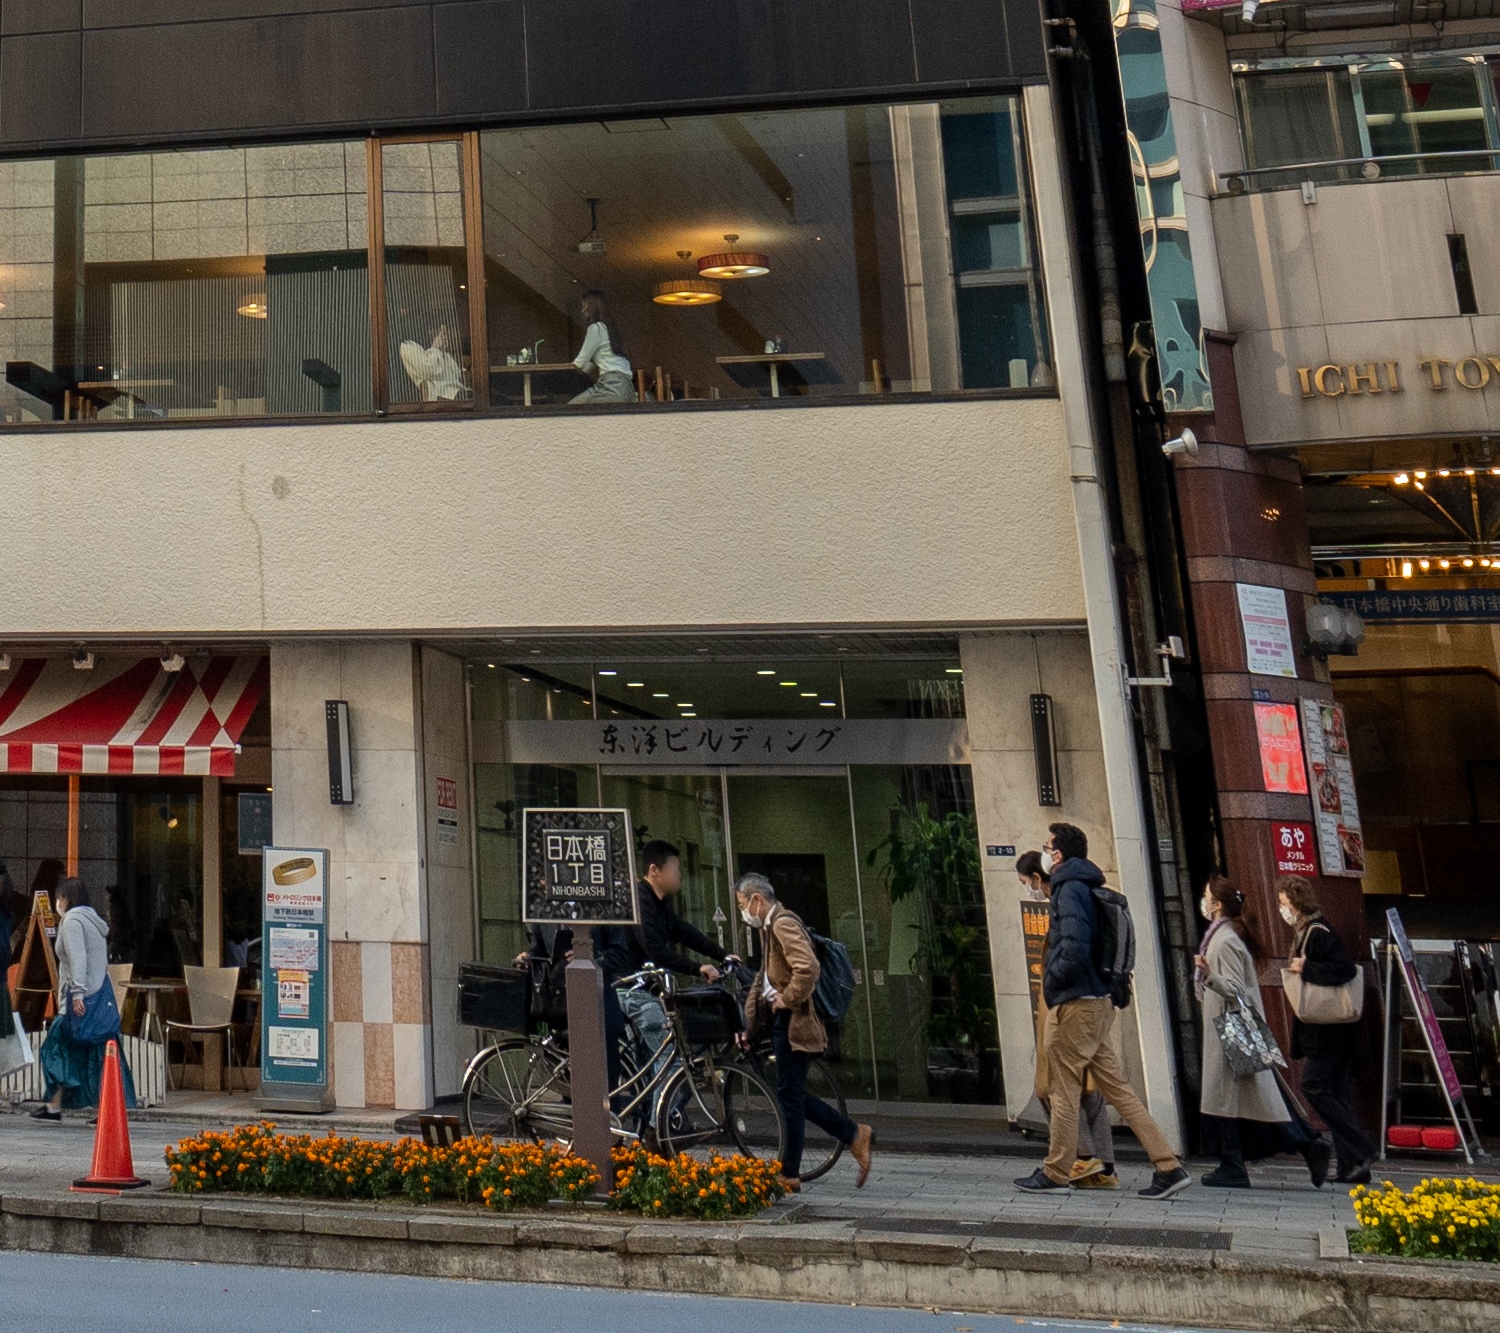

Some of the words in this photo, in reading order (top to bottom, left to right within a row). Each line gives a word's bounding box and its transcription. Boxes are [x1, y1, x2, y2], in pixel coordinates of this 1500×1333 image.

[1297, 361, 1403, 398] ICHI
[599, 723, 843, 755] 東洋ビルディング
[547, 835, 607, 861] 日本橋
[1280, 826, 1305, 849] あや
[552, 863, 605, 884] 1丁目
